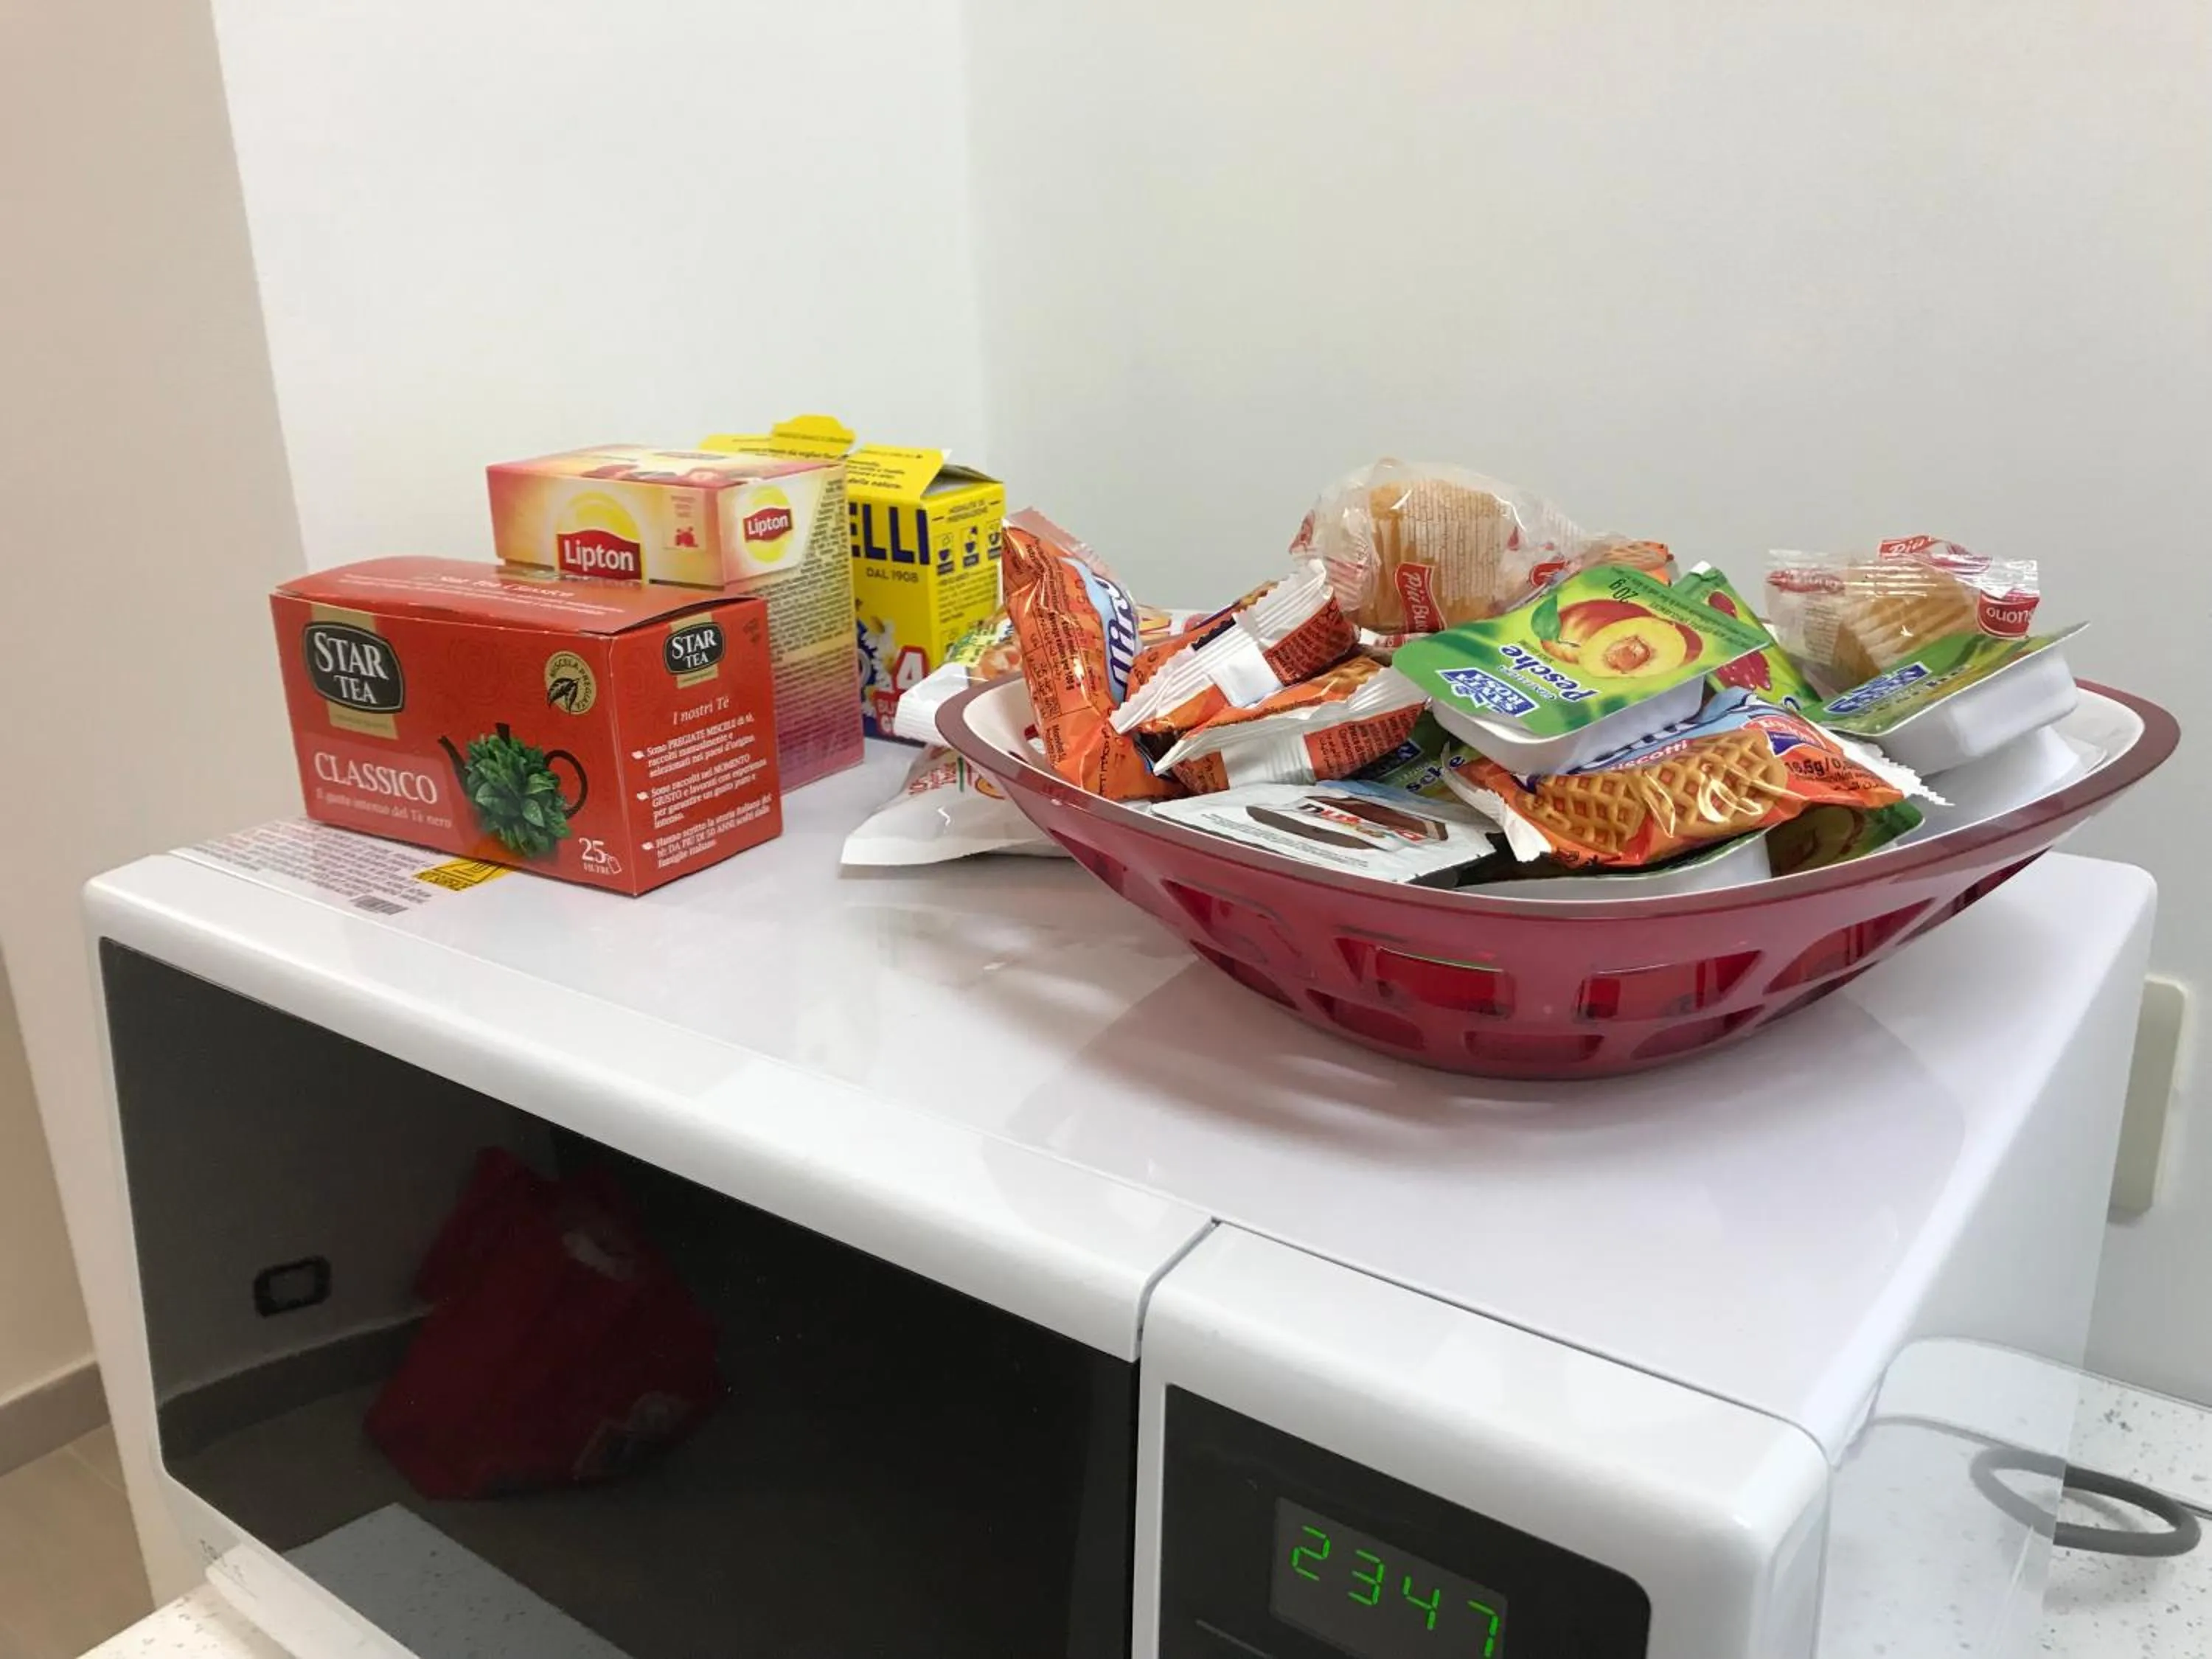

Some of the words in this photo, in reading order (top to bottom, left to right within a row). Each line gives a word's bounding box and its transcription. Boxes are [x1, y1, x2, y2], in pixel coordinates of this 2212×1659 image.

[748, 515, 789, 537] Lipton
[564, 540, 635, 572] Lipton
[866, 567, 890, 581] DAL
[313, 631, 389, 681] STAR
[670, 630, 717, 661] STAR
[684, 653, 709, 669] TEA
[1499, 643, 1599, 703] Pesche
[333, 675, 378, 704] TEA
[681, 702, 714, 722] nostri
[314, 751, 437, 804] CLASSICO
[578, 837, 605, 863] 25
